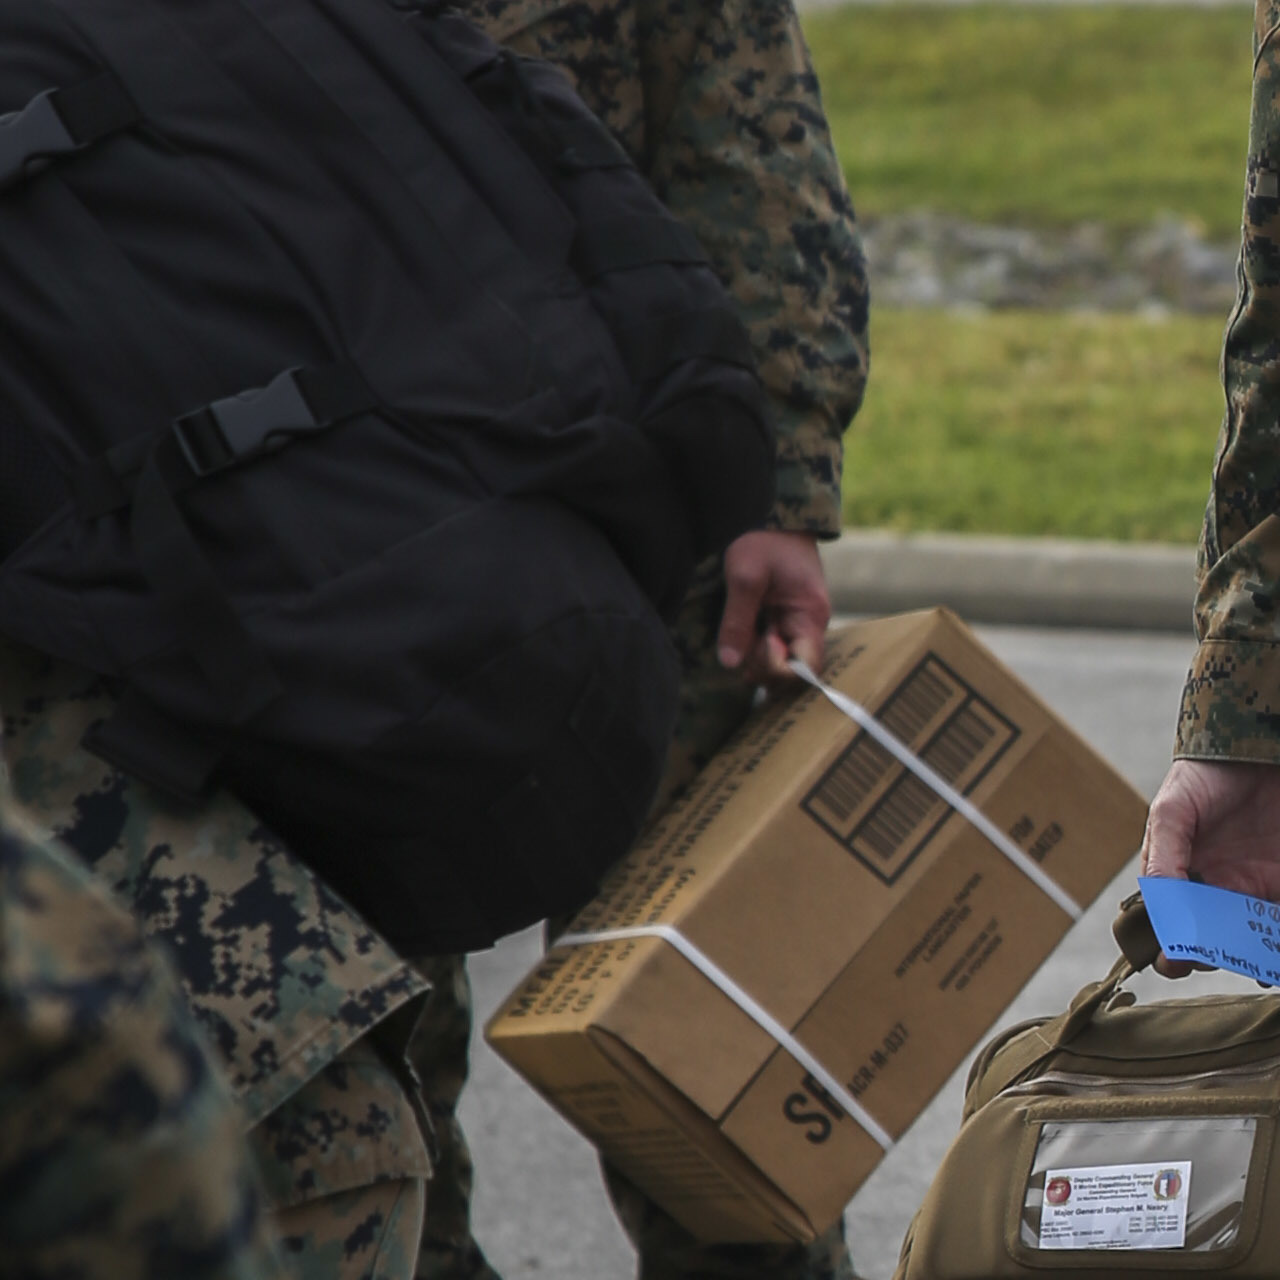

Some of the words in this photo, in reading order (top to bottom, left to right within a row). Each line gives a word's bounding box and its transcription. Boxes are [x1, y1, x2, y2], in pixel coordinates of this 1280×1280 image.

[665, 782, 746, 858] HANDLE
[1094, 1173, 1131, 1182] Commanding
[1053, 1208, 1073, 1217] Major
[1075, 1206, 1103, 1215] General
[1105, 1204, 1134, 1214] Stephen
[1146, 1202, 1167, 1212] Neary
